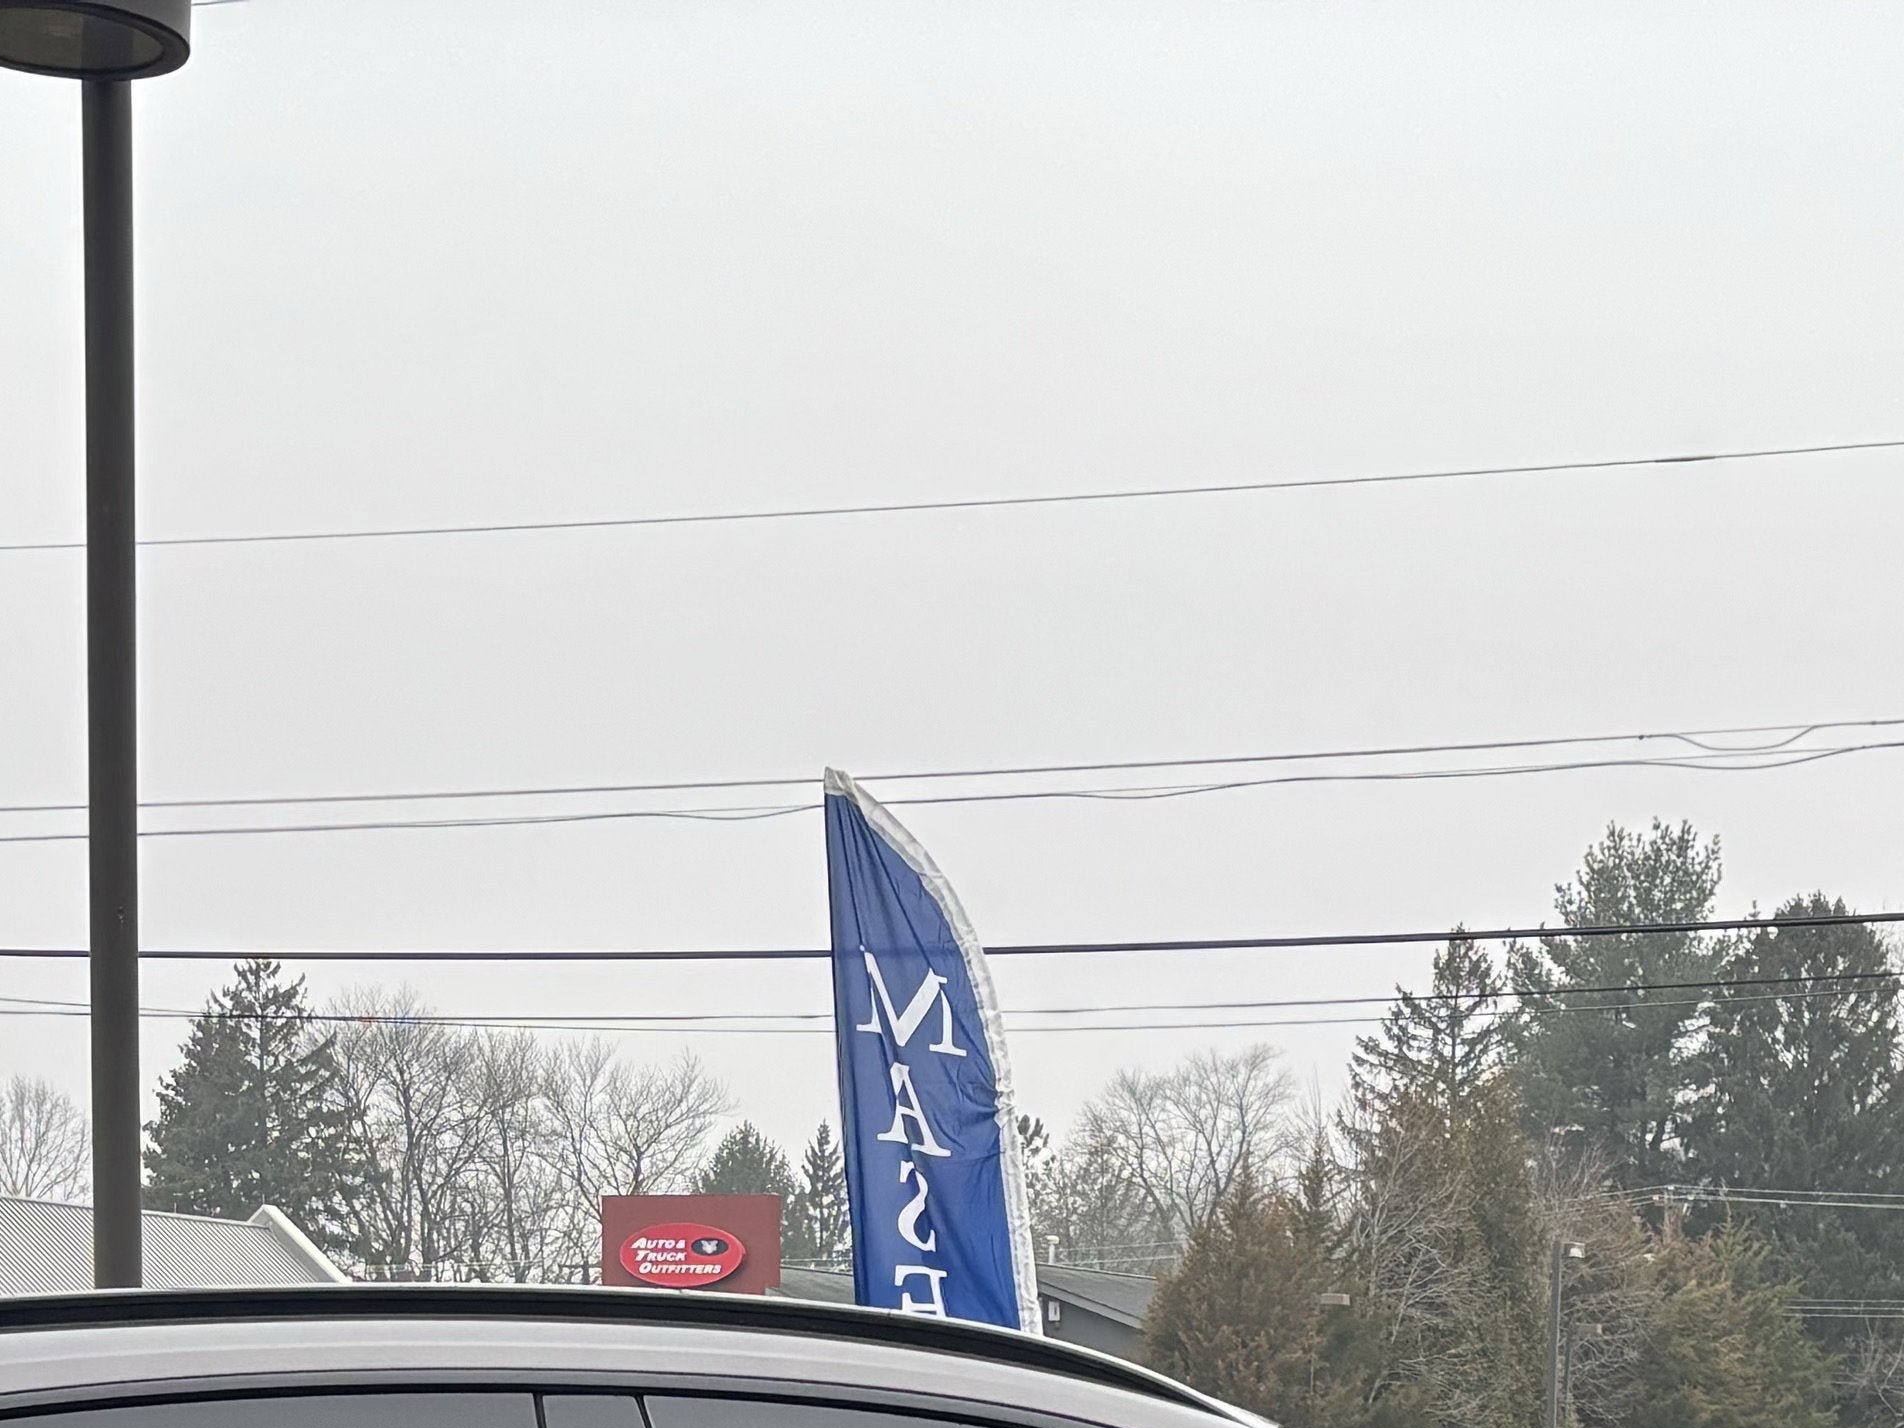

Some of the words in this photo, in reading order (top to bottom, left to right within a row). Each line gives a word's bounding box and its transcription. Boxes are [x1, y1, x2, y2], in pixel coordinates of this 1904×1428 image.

[631, 1237, 674, 1249] AUTO
[635, 1250, 687, 1261] TRUCK
[639, 1262, 722, 1274] OUTFITTERS
